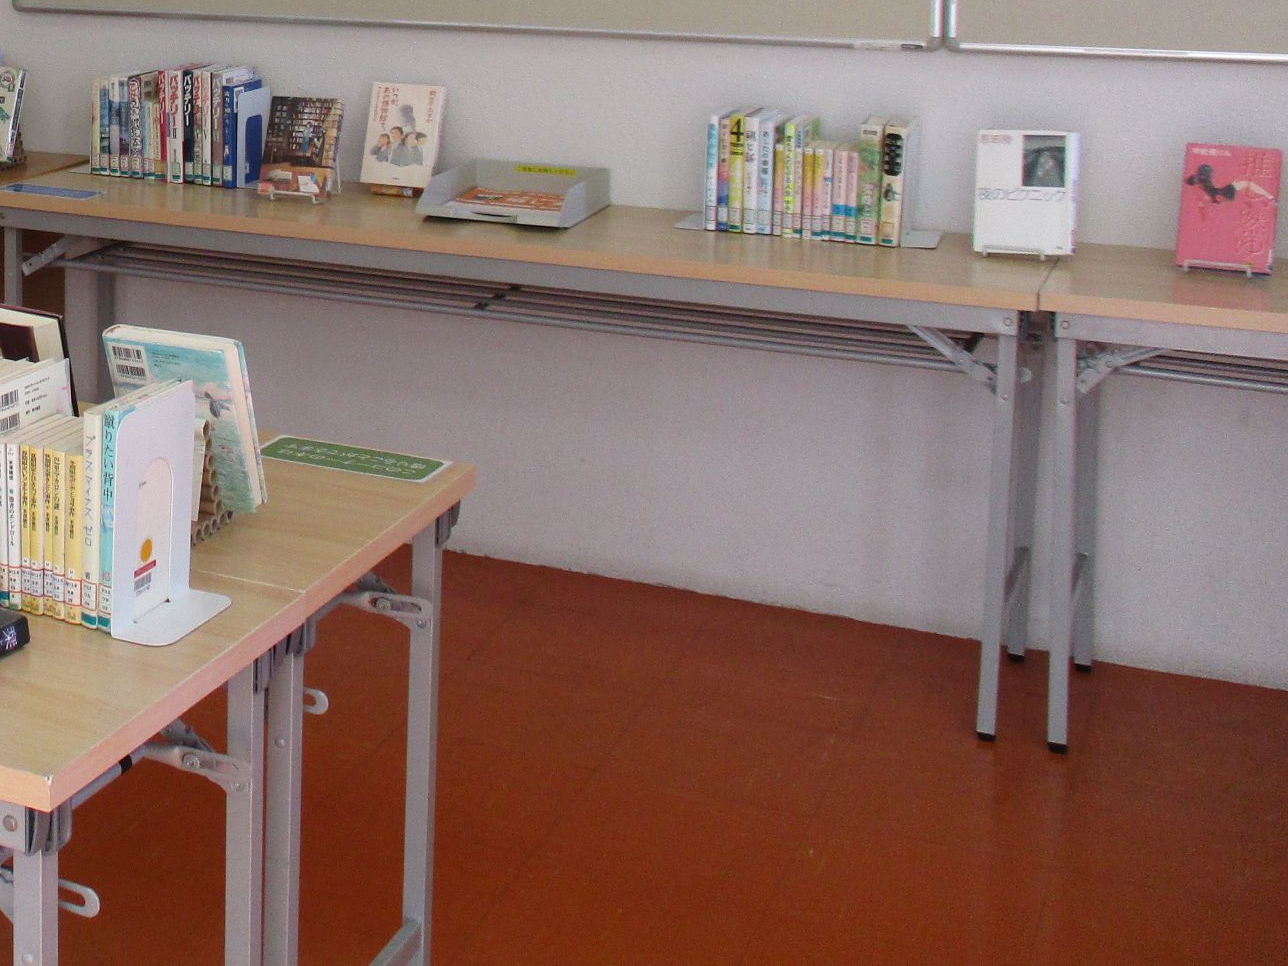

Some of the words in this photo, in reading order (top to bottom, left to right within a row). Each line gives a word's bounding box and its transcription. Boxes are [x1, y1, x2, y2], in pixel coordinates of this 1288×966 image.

[183, 74, 192, 127] バッテリー
[103, 413, 115, 502] 蹴りたい背中
